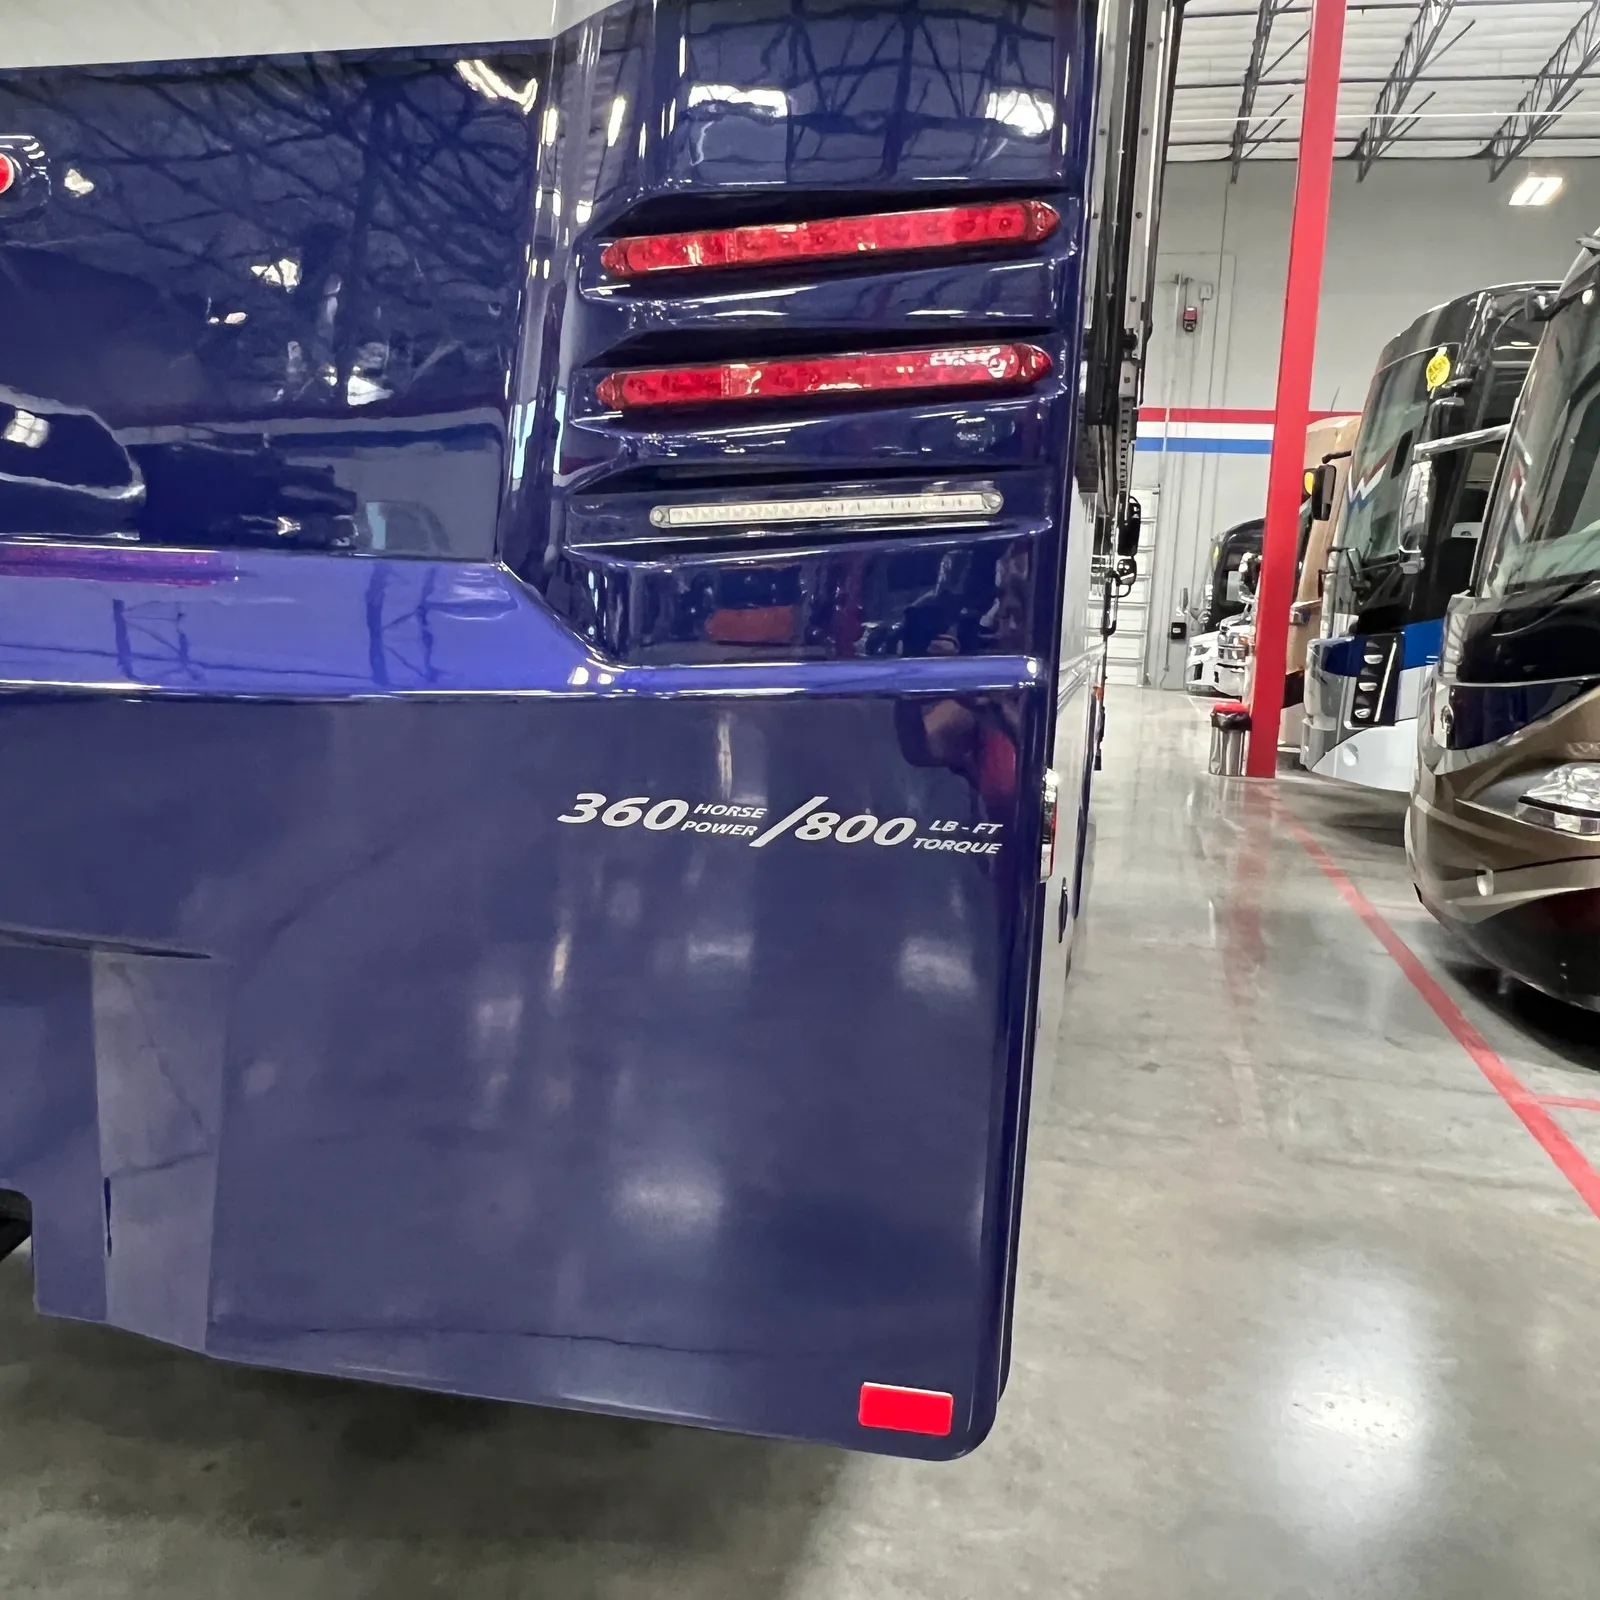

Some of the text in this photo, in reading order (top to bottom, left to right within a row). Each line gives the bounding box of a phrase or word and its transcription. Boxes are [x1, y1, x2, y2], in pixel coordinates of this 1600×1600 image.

[557, 792, 690, 831] 360
[693, 803, 768, 819] HORSE
[681, 820, 758, 836] POWER
[929, 819, 959, 832] LB
[972, 822, 1004, 835] FT
[912, 837, 1003, 854] TORQUE
